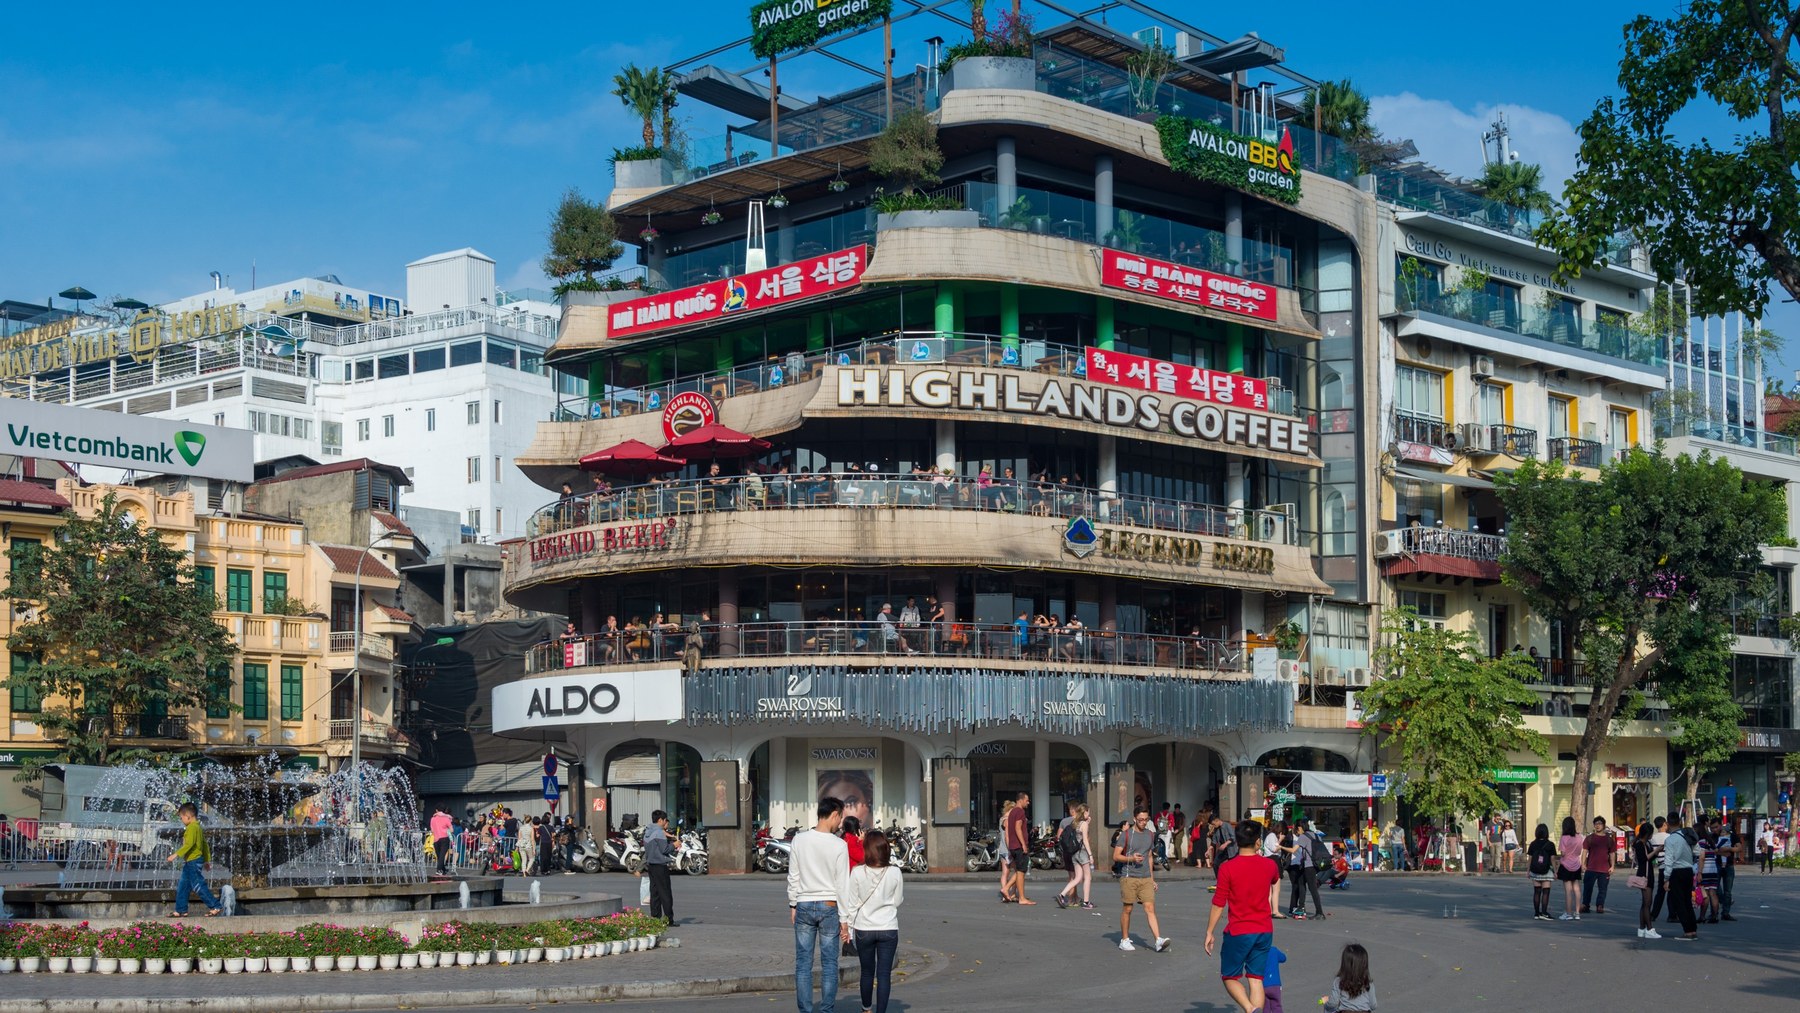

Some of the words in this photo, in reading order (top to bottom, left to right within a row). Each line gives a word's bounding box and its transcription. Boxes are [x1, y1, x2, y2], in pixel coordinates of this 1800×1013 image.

[759, 0, 814, 28] AVALON
[818, 0, 869, 27] garden
[1189, 129, 1248, 160] AVALON
[1248, 168, 1293, 190] garden
[755, 266, 804, 299] 서울
[810, 252, 859, 285] 식당
[1405, 232, 1430, 256] Cau
[1434, 239, 1453, 262] Go
[1460, 252, 1528, 282] Vietnamese
[1116, 257, 1147, 275] MÌ
[1152, 266, 1202, 287] HÀN
[1208, 278, 1267, 301] QUỐC
[1123, 274, 1160, 293] 등촌
[1168, 285, 1201, 302] 샤브
[1208, 293, 1259, 312] 칼국수
[170, 304, 243, 343] HOTEL
[613, 306, 634, 330] MÌ
[637, 302, 671, 325] HÀN
[674, 288, 717, 319] QUỐC
[37, 344, 63, 372] DE
[66, 331, 119, 366] VILLE
[1127, 360, 1177, 394] 서울
[1189, 368, 1236, 403] 식당
[664, 395, 712, 423] HIGHLANDS
[837, 367, 1162, 431] HIGHLANDS
[1168, 400, 1309, 456] COFFEE
[8, 423, 175, 465] Vietcombank
[529, 531, 595, 562] LEGEND
[603, 523, 666, 551] BEER
[1101, 528, 1203, 563] LEGEND
[1212, 542, 1275, 572] BEER
[527, 683, 620, 718] ALDO
[758, 697, 842, 711] SWAROVSKI
[1043, 701, 1106, 716] SWAROVSKI
[812, 748, 878, 759] SWAROVSKI
[971, 743, 1008, 755] AROVSKI
